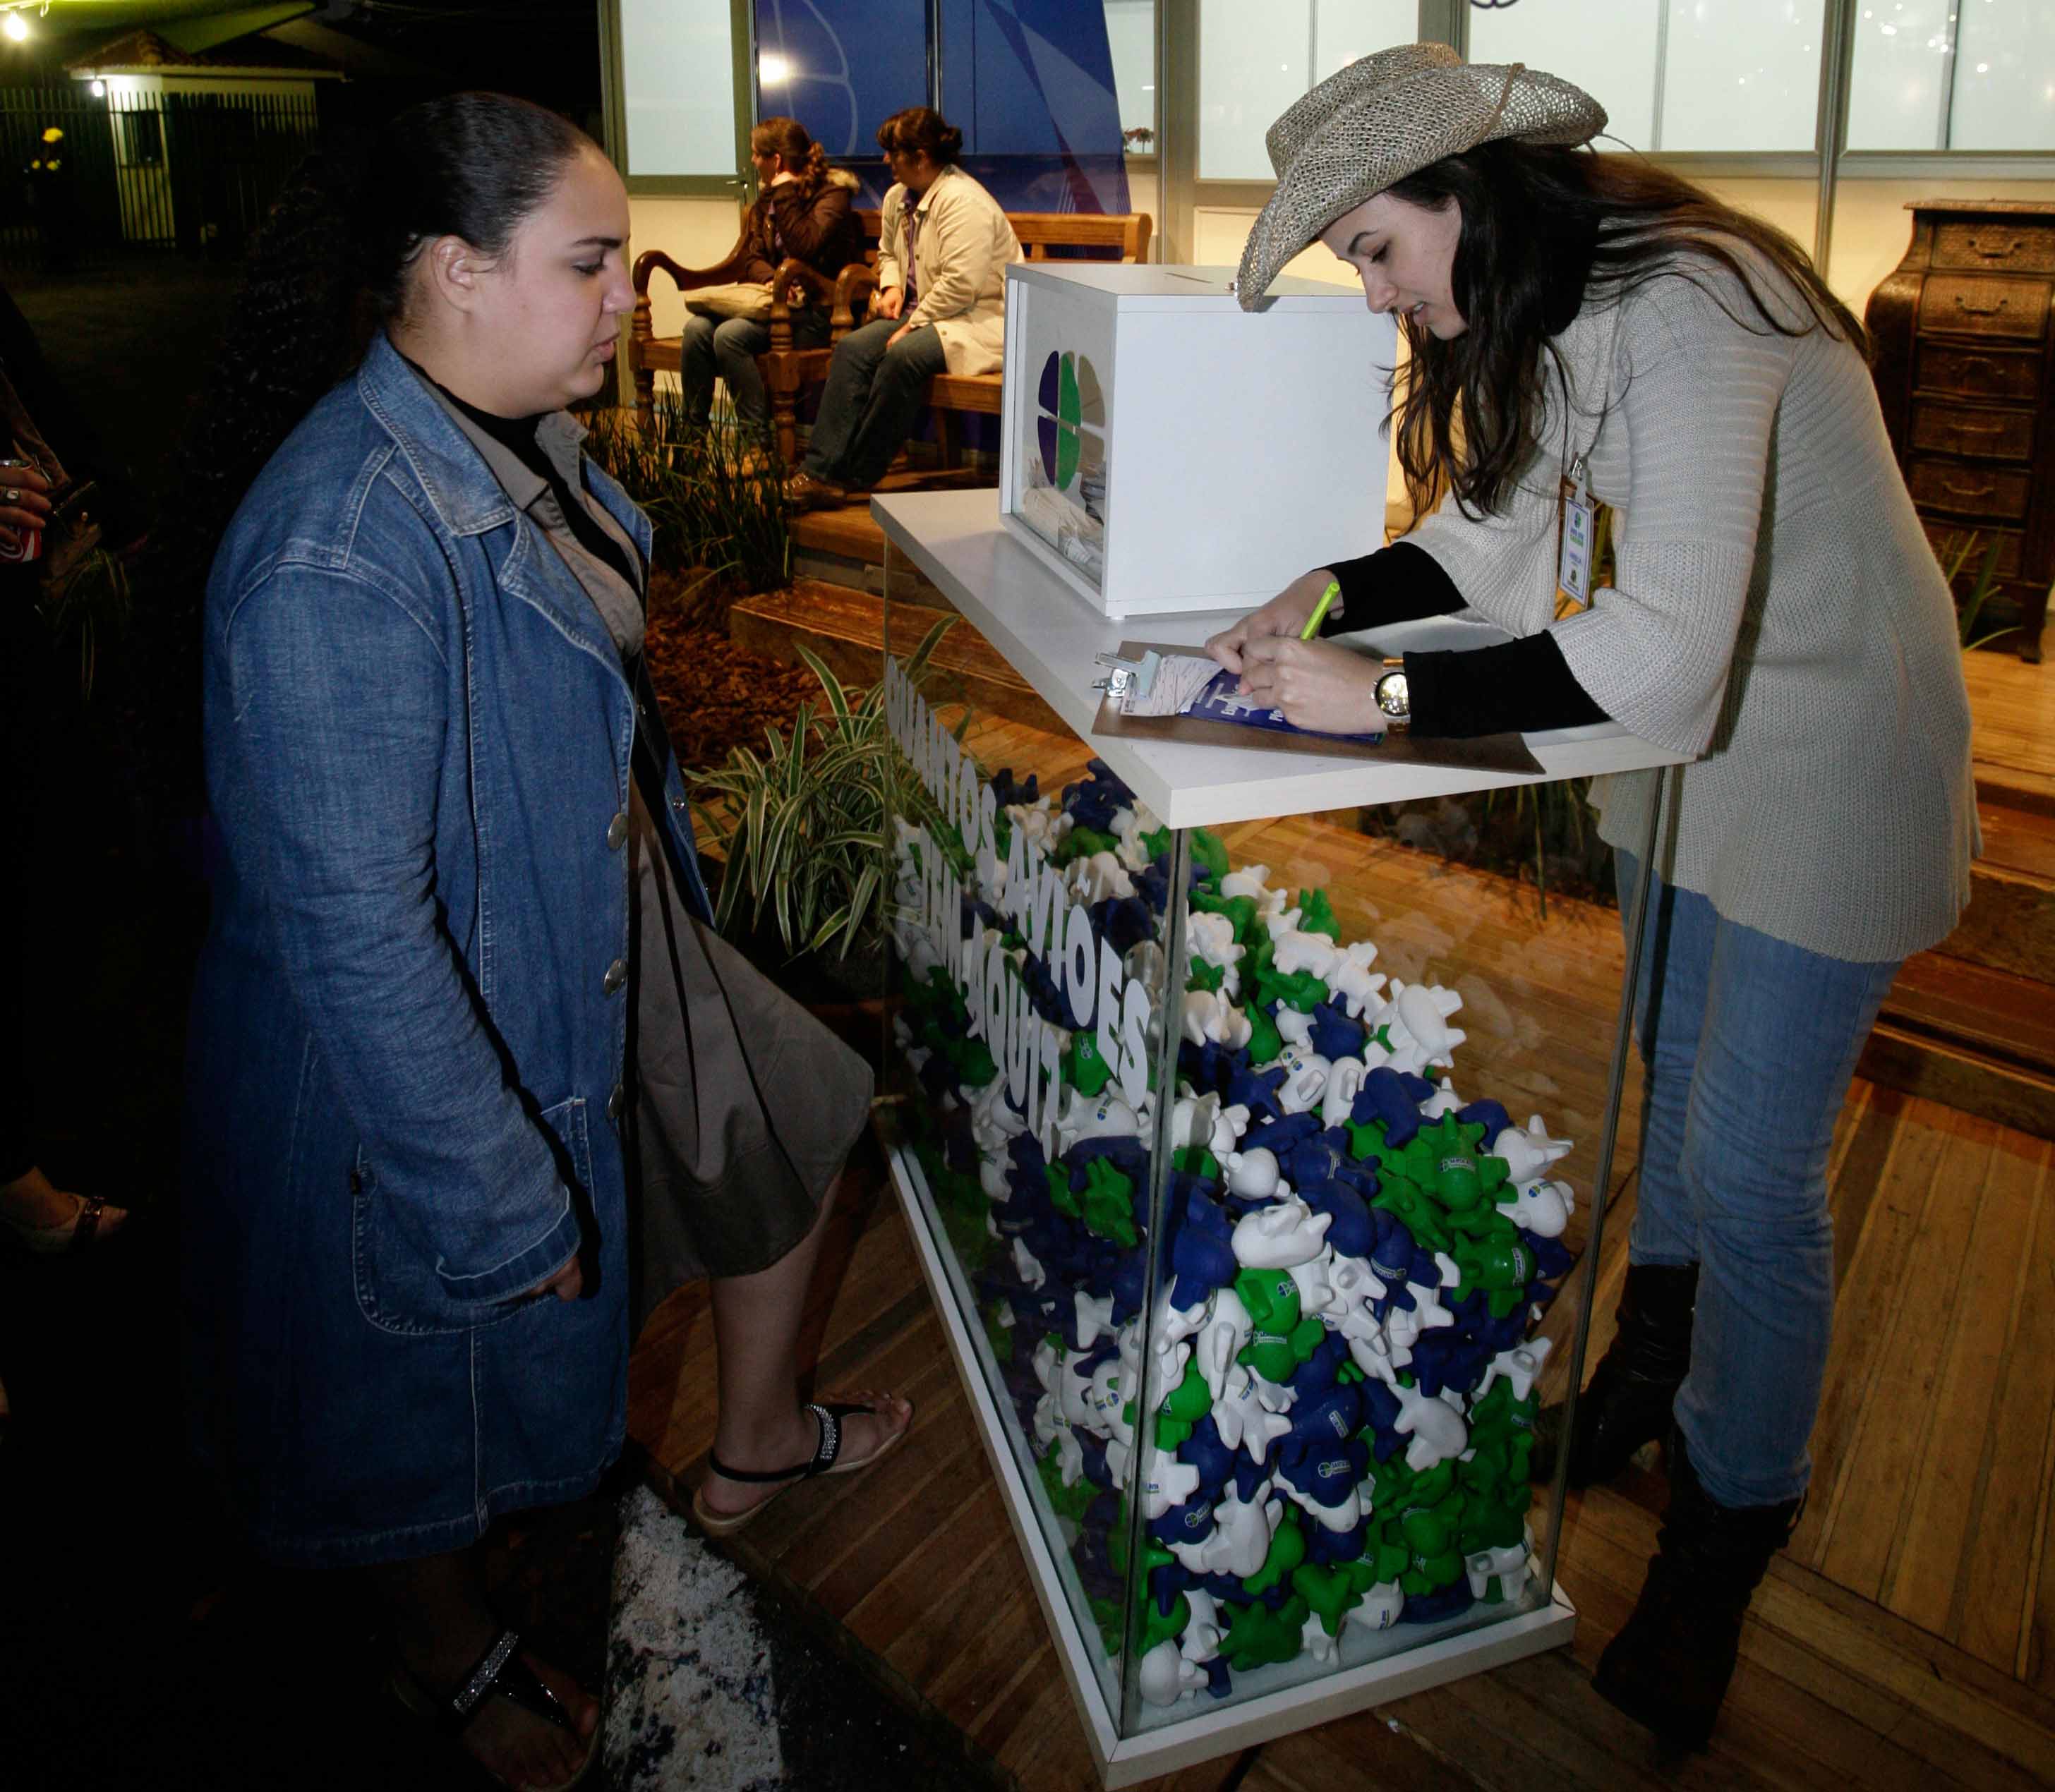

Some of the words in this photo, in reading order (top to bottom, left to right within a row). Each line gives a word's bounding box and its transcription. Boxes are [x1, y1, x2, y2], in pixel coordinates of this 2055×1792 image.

[886, 654, 997, 885] QUANTOS
[1005, 823, 1150, 1108] AVIÕES
[920, 821, 961, 995] TEM
[965, 912, 1059, 1166] AQUI?
